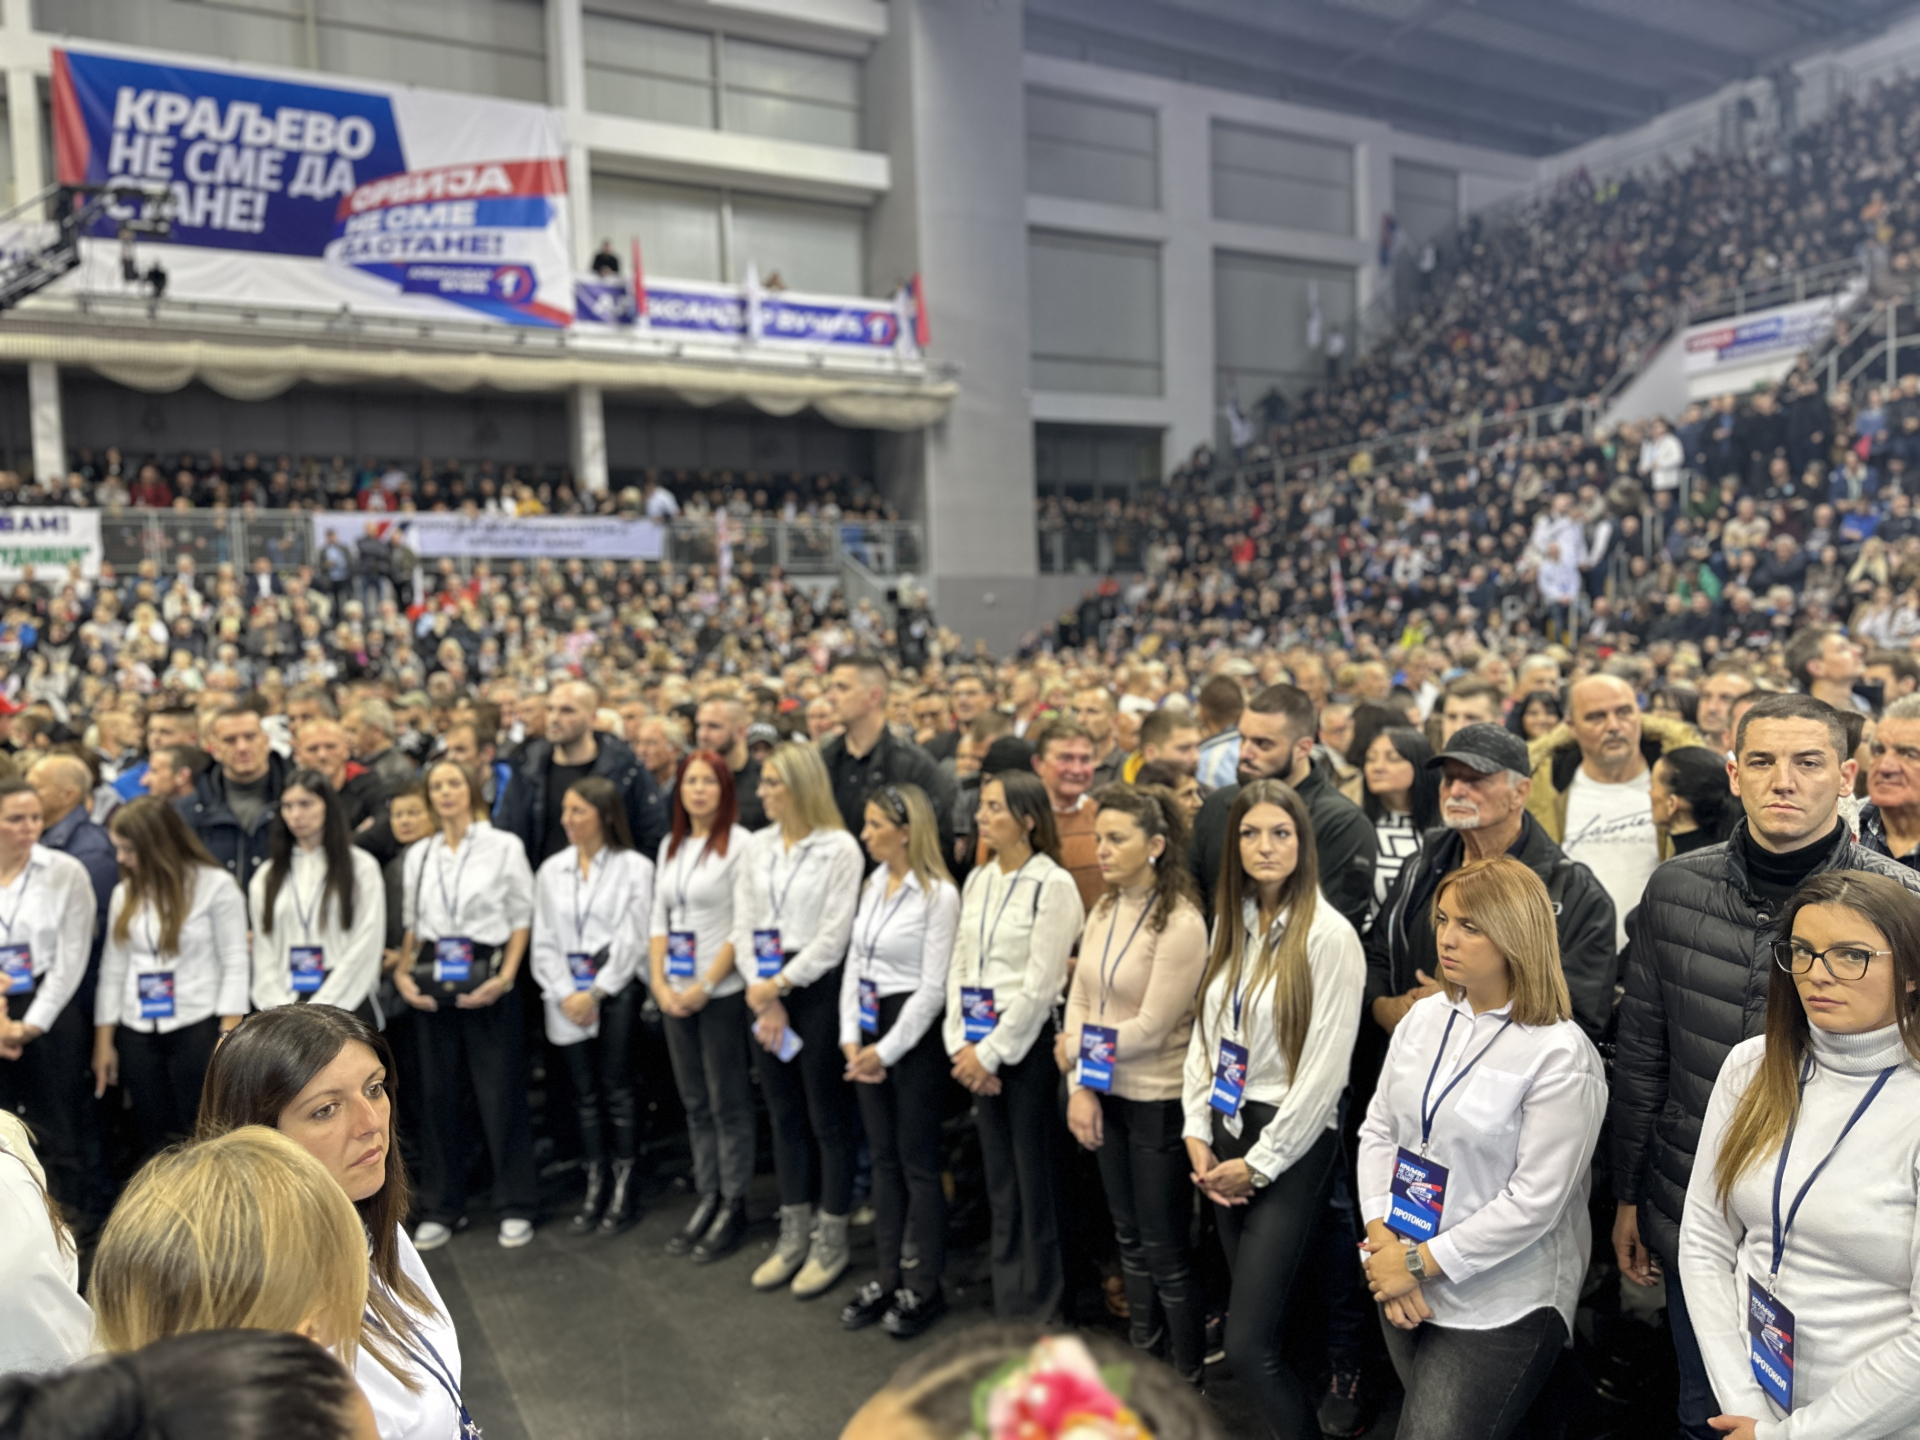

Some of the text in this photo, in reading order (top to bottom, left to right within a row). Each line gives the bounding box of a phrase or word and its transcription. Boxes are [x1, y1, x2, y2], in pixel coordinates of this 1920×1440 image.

[114, 87, 375, 160] КРАЉЕВО
[108, 131, 356, 200] НЕ СМЕ ДА
[1393, 1207, 1432, 1231] ПРОТОКОЛ
[1753, 1351, 1787, 1391] ПРОТОКОЛ
